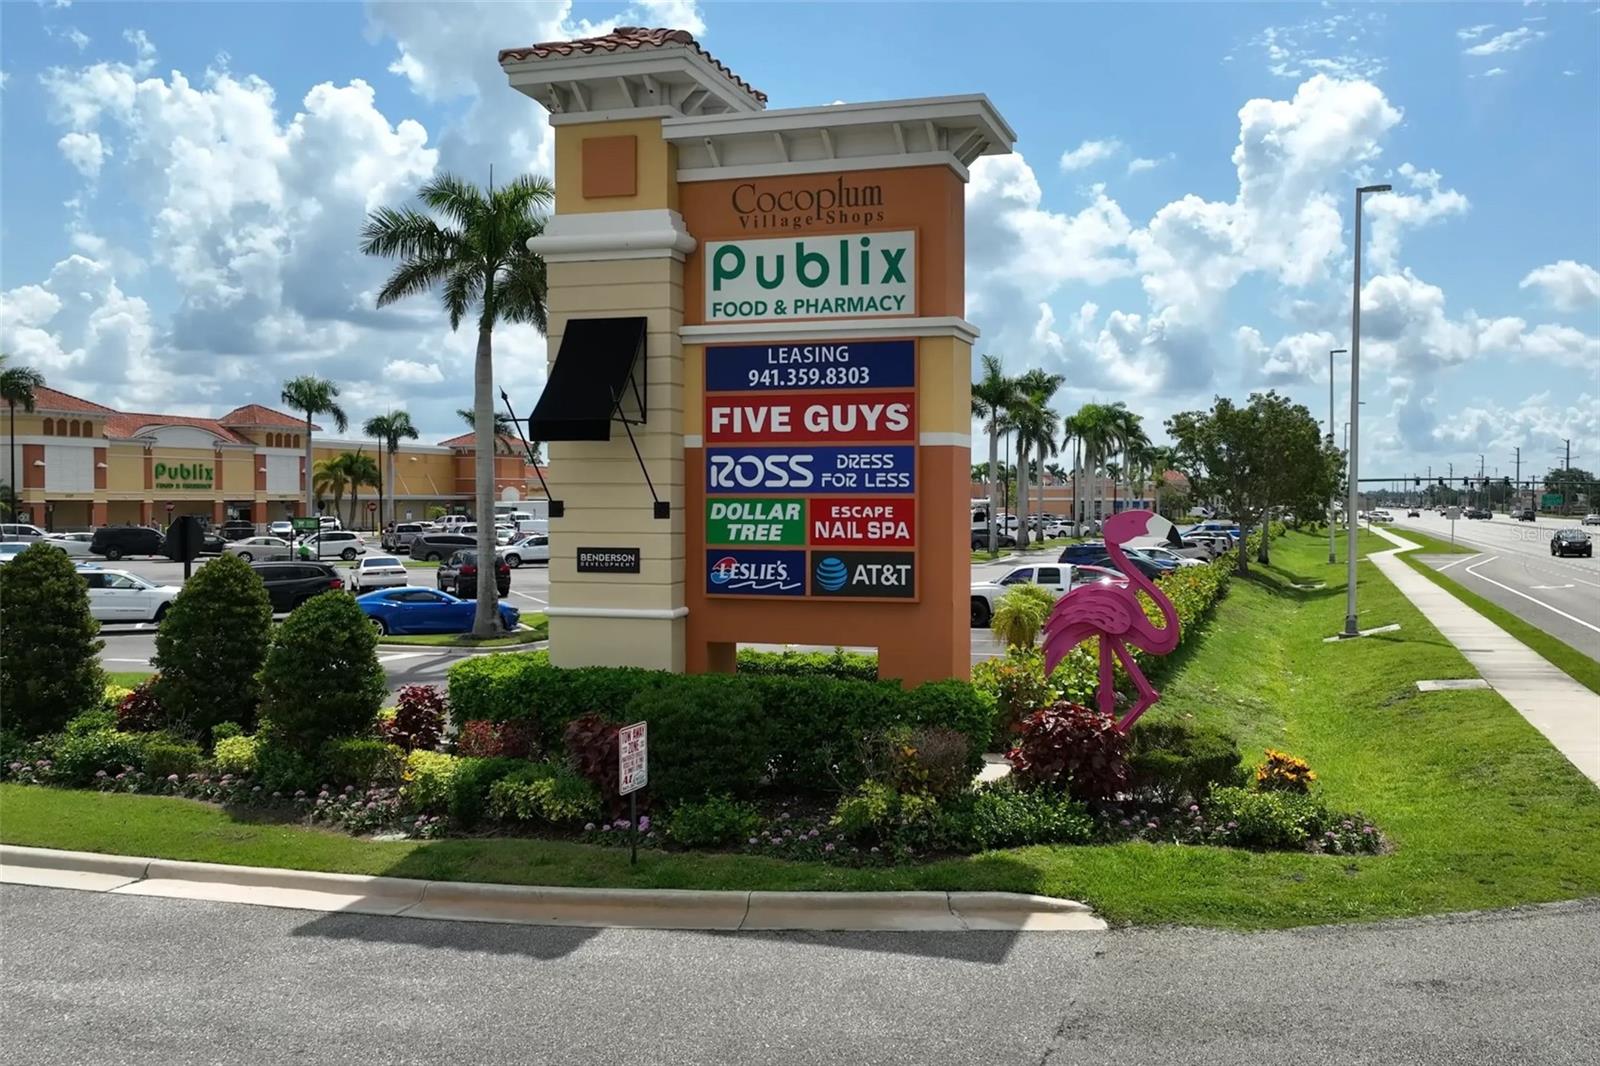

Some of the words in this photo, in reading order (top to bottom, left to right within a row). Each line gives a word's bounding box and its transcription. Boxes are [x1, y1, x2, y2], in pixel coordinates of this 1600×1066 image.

[732, 176, 883, 221] Cocoplum
[739, 214, 814, 230] Village
[826, 209, 884, 226] Shops
[713, 236, 907, 291] Publix
[713, 301, 768, 318] FOOD
[774, 300, 787, 315] &
[793, 295, 906, 314] PHARMACY
[768, 345, 849, 364] LEASING
[748, 367, 870, 387] 941.359.8303
[711, 406, 792, 433] FIVE
[804, 403, 910, 432] GUYS
[710, 454, 814, 488] ROSS
[837, 454, 894, 469] DRESS
[155, 462, 213, 481] Publix
[821, 473, 857, 488] FOR
[865, 472, 910, 488] LESS
[710, 503, 801, 520] DOLLAR
[831, 506, 894, 518] ESCAPE
[727, 524, 783, 541] TREE
[815, 521, 863, 538] NAIL
[867, 521, 910, 539] SPA
[580, 553, 635, 562] BENDERSON
[719, 560, 788, 580] LESLIE'S
[852, 564, 911, 586] AT&T
